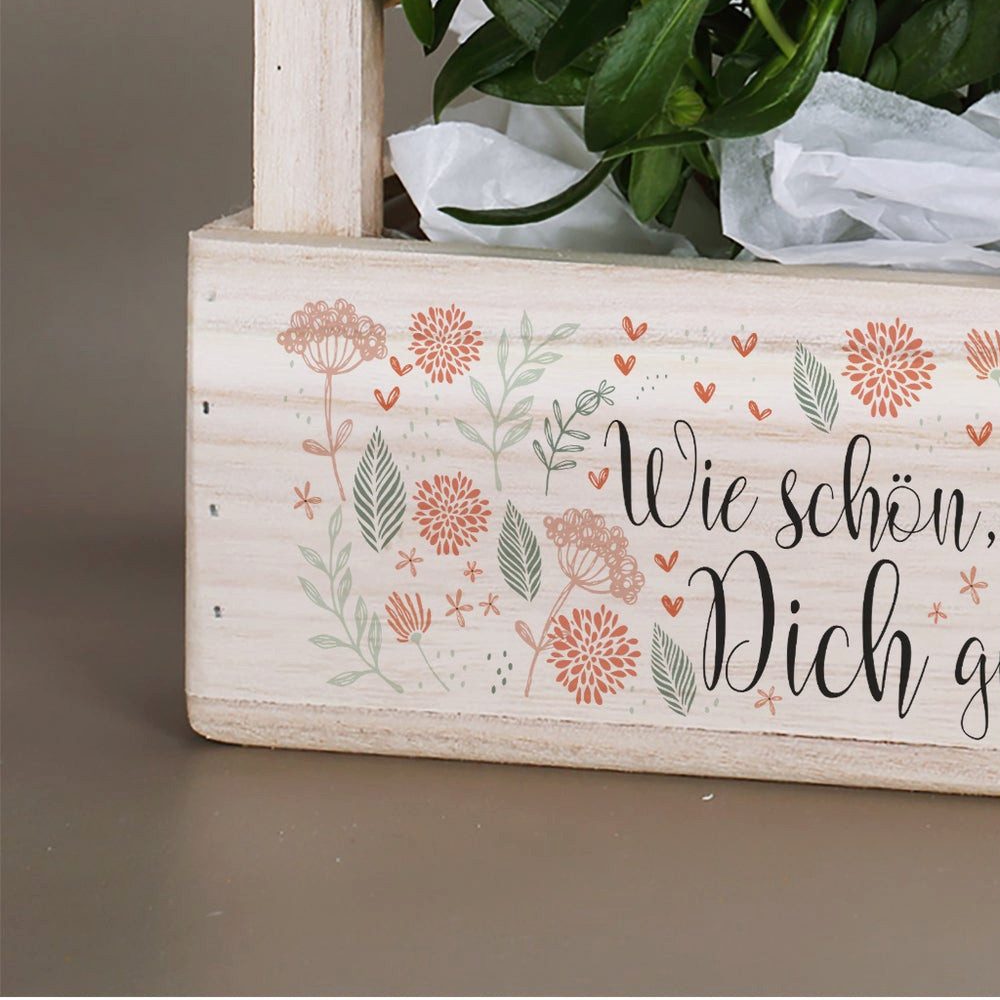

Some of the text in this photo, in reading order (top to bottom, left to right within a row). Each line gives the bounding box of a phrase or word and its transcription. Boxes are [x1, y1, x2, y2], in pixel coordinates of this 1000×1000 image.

[604, 419, 758, 532] Wie
[773, 434, 995, 552] schön,
[688, 550, 929, 719] Dich
